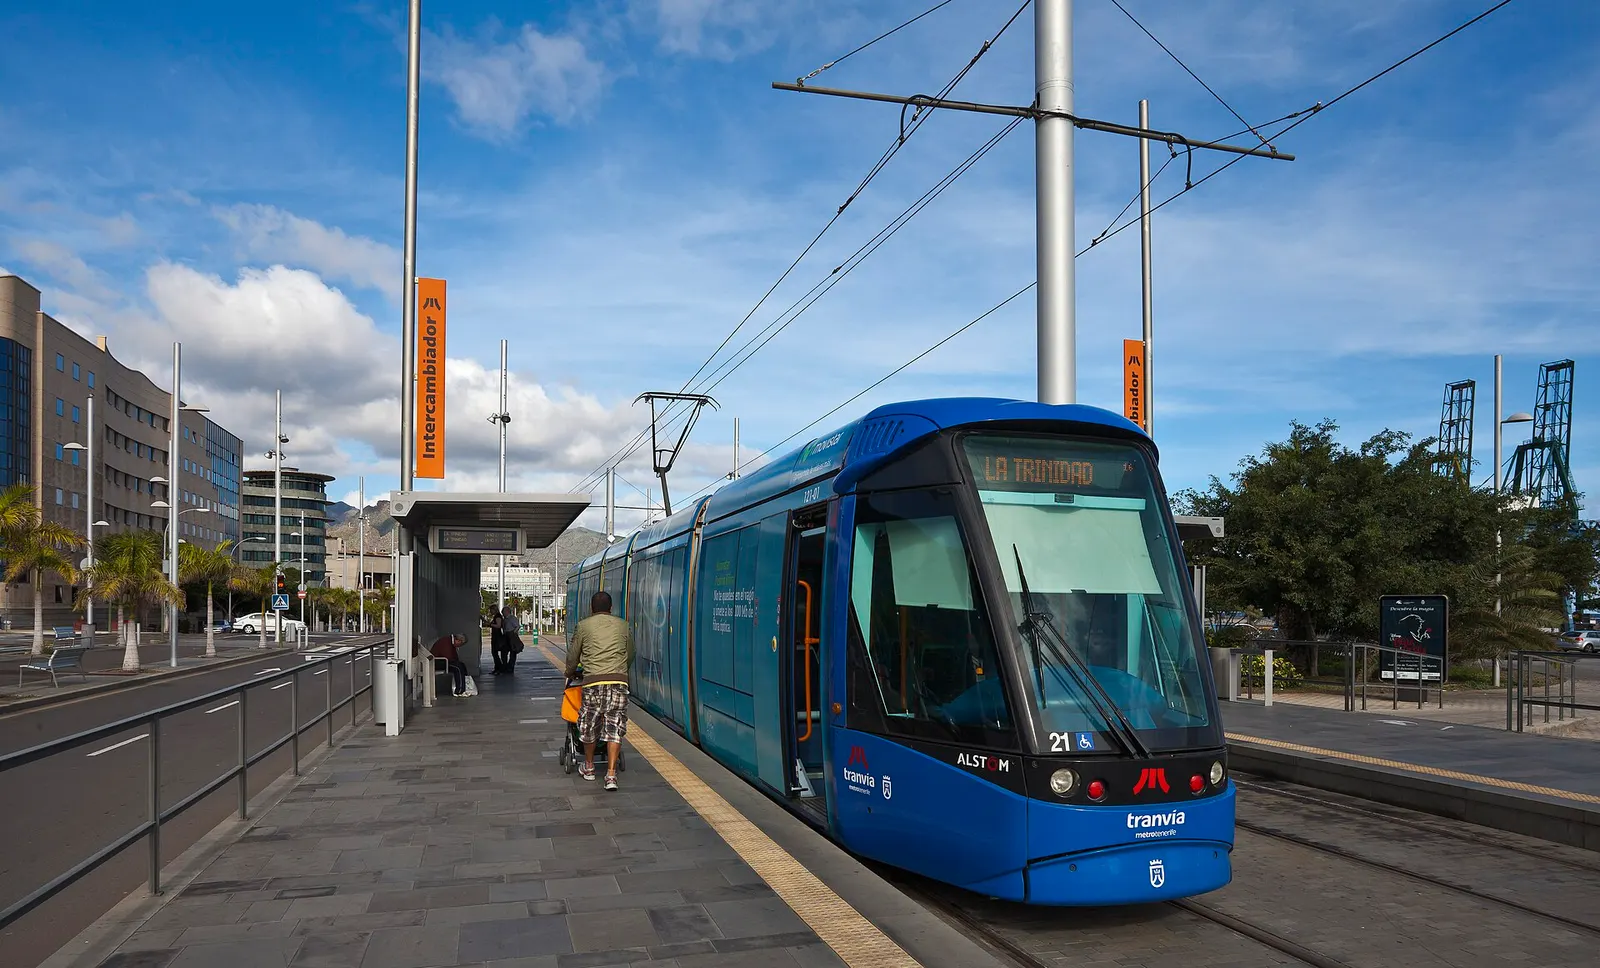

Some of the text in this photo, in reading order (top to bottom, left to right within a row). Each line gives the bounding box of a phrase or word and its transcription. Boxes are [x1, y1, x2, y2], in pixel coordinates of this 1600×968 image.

[422, 315, 437, 459] Intercambiador
[1129, 371, 1139, 424] biador
[985, 456, 1094, 485] LA TRINIDAD
[744, 586, 754, 604] vagó
[1049, 732, 1070, 752] 21
[957, 752, 1009, 773] ALSTOM
[1126, 809, 1185, 829] tranvía
[1135, 829, 1177, 839] metrotenerife
